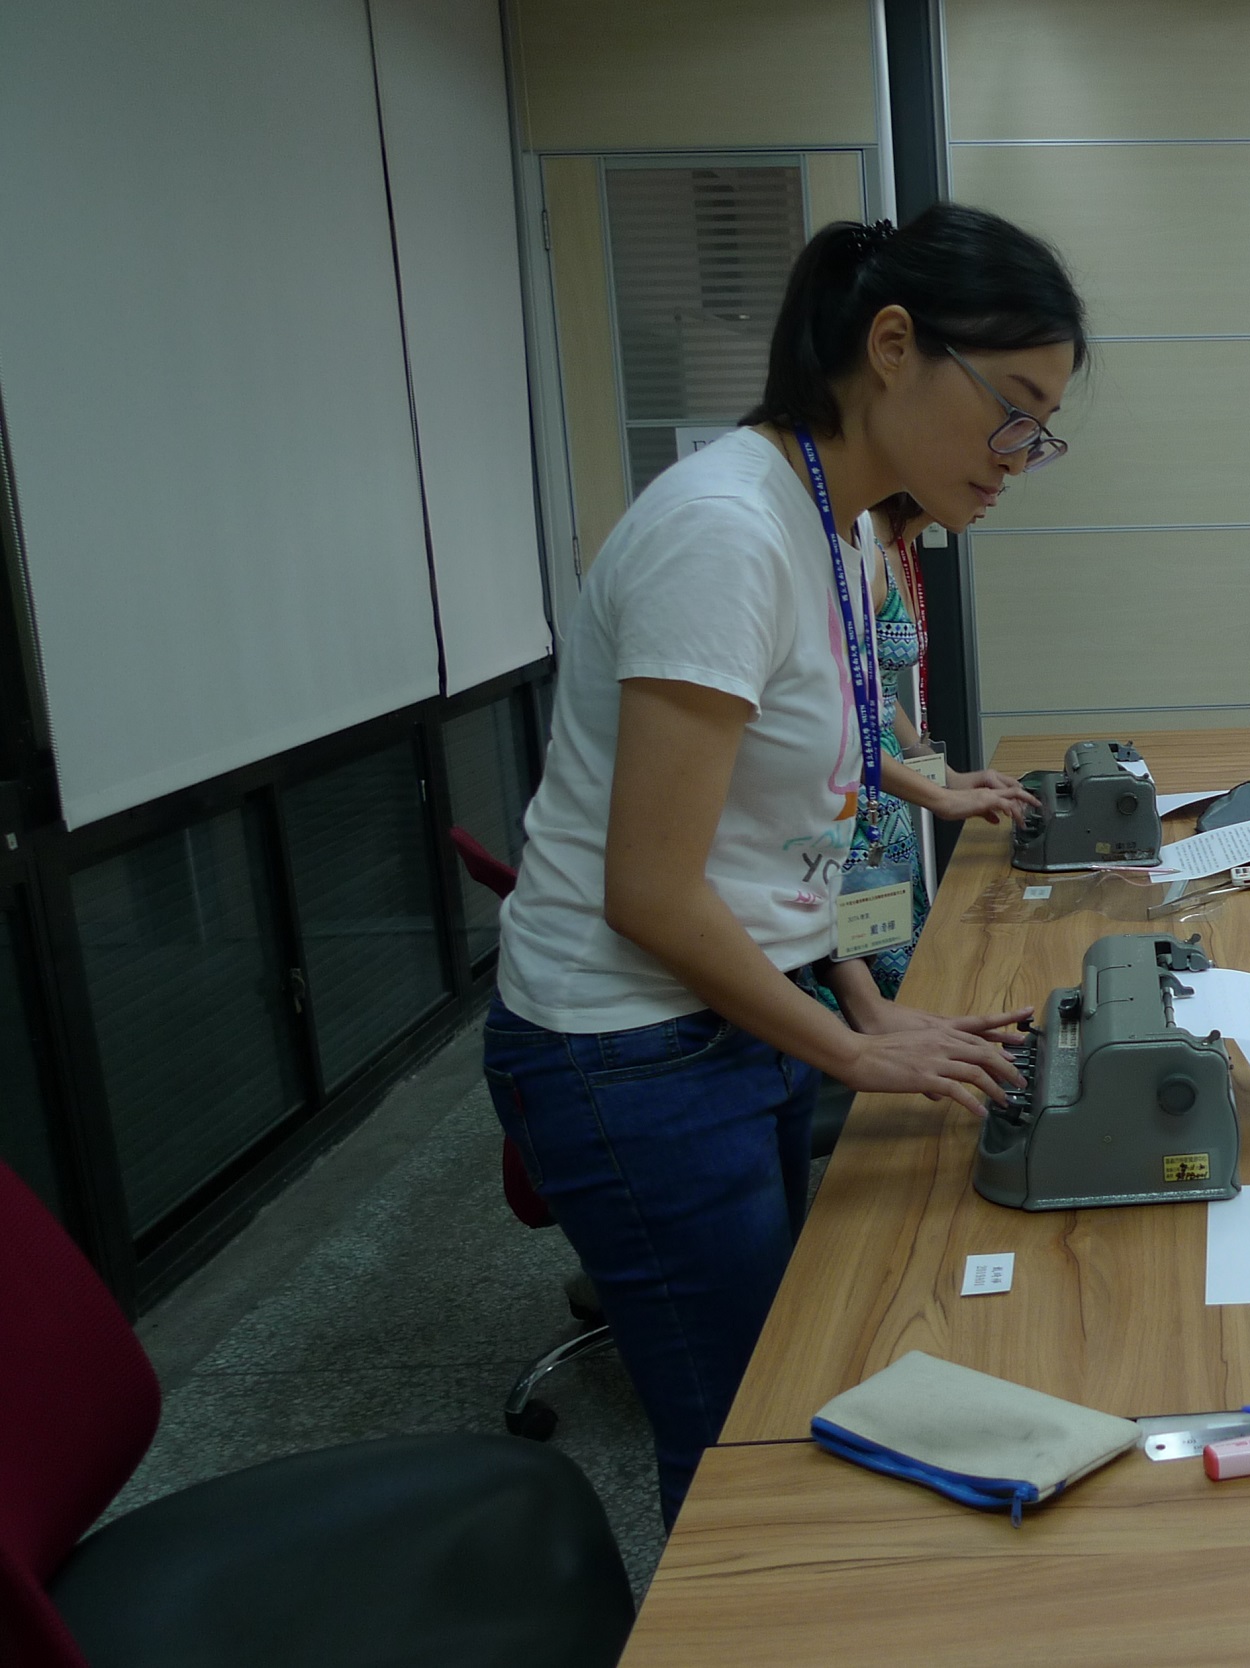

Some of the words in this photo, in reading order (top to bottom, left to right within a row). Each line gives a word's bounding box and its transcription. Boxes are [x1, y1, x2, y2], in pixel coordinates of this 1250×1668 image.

[803, 442, 816, 462] NUTN
[848, 620, 856, 640] NUTN
[860, 704, 868, 723] NUTN
